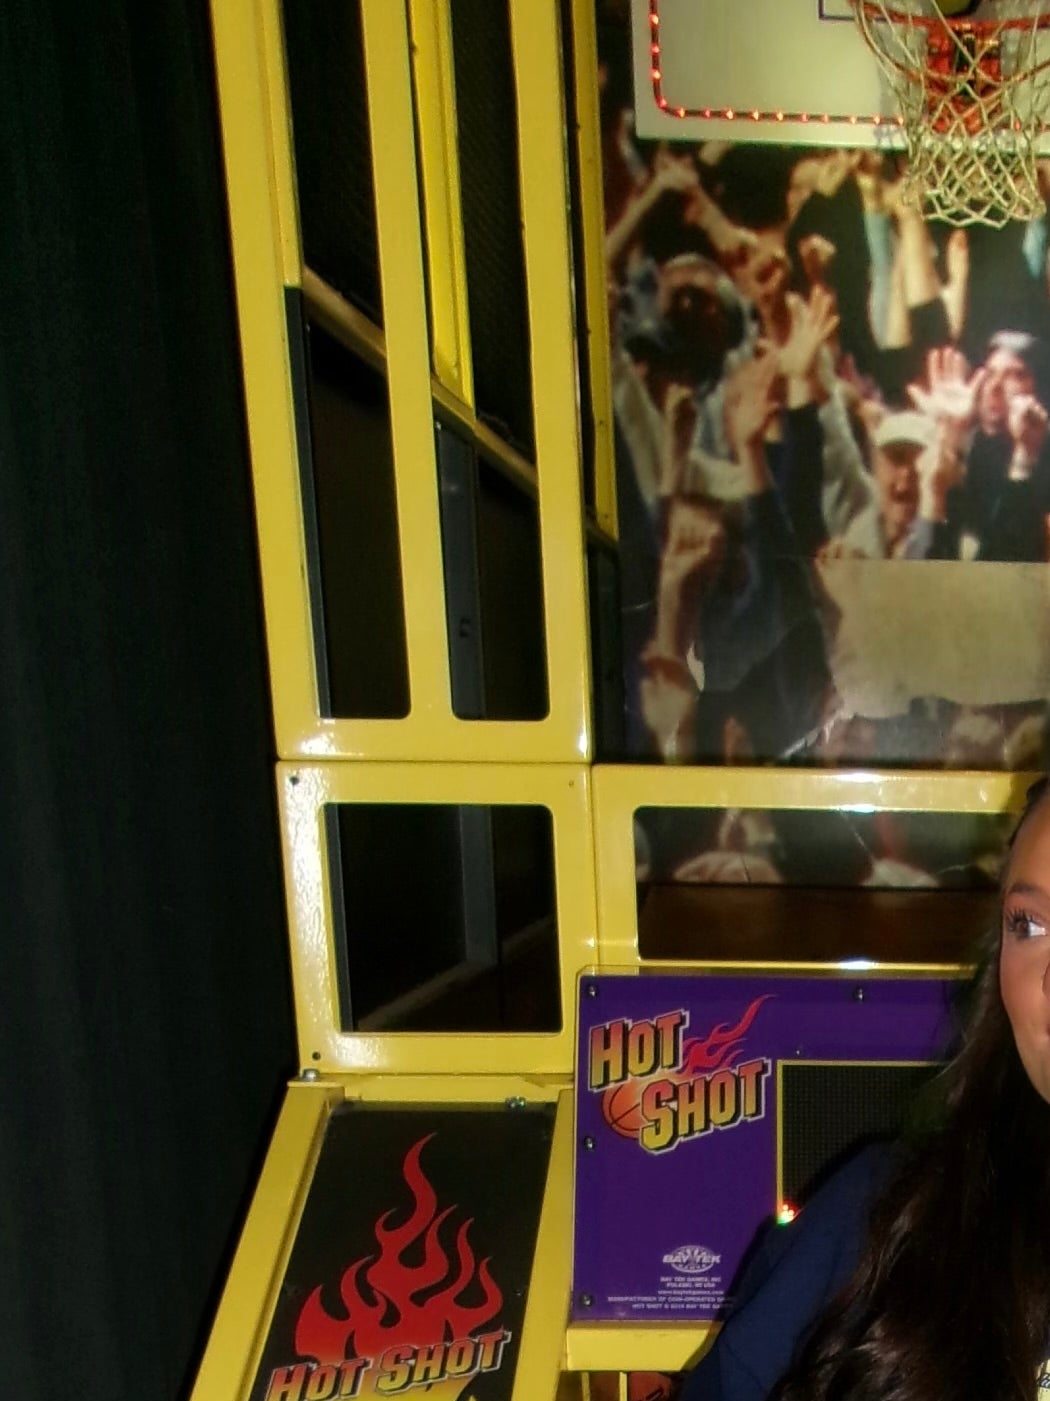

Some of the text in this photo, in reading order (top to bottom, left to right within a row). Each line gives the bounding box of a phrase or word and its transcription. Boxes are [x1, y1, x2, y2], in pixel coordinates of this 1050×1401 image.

[589, 1010, 689, 1091] HOT
[640, 1059, 770, 1154] SHOT
[375, 1331, 511, 1396] SHOT
